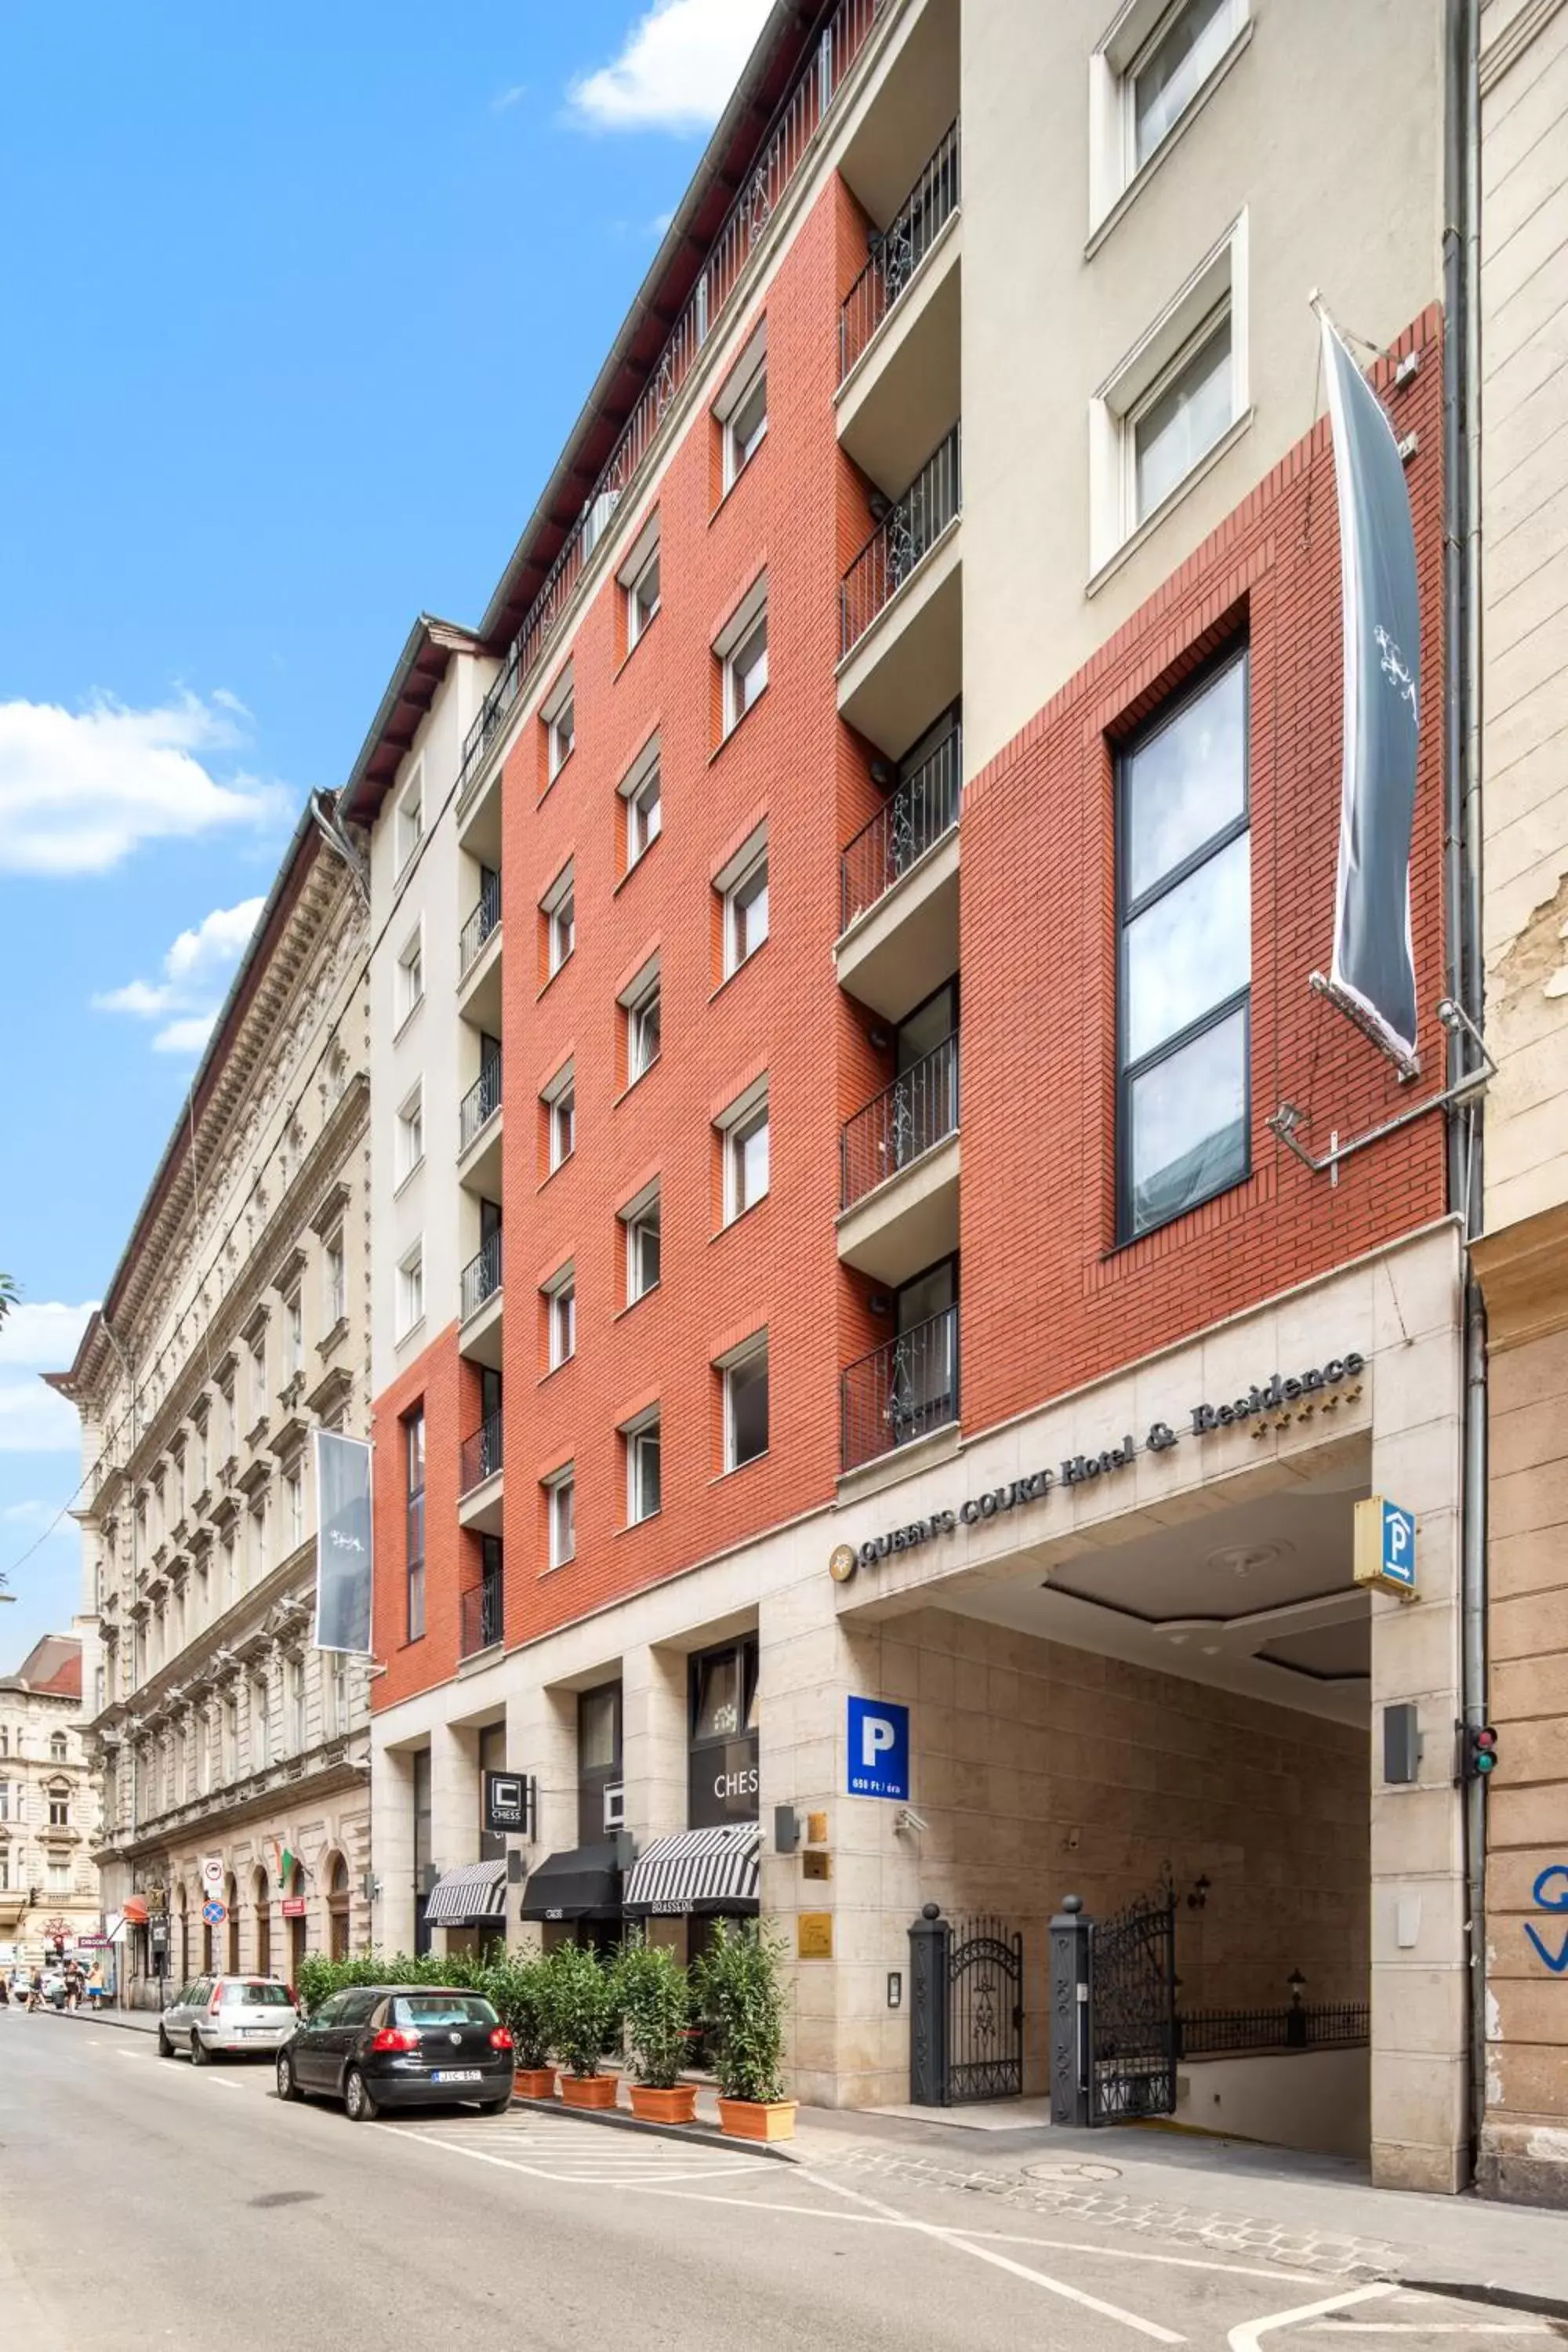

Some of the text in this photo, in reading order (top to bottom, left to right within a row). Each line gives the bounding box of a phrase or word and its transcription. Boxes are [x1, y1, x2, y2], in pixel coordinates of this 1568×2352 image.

[959, 1468, 1054, 1525] COURT
[1059, 1435, 1136, 1486] Hotel
[1145, 1422, 1179, 1453] &
[1190, 1352, 1365, 1436] Residence
[1392, 1522, 1406, 1563] P
[862, 1715, 895, 1767] P
[492, 1810, 521, 1820] CHESS
[652, 1900, 695, 1913] BRASSERIE
